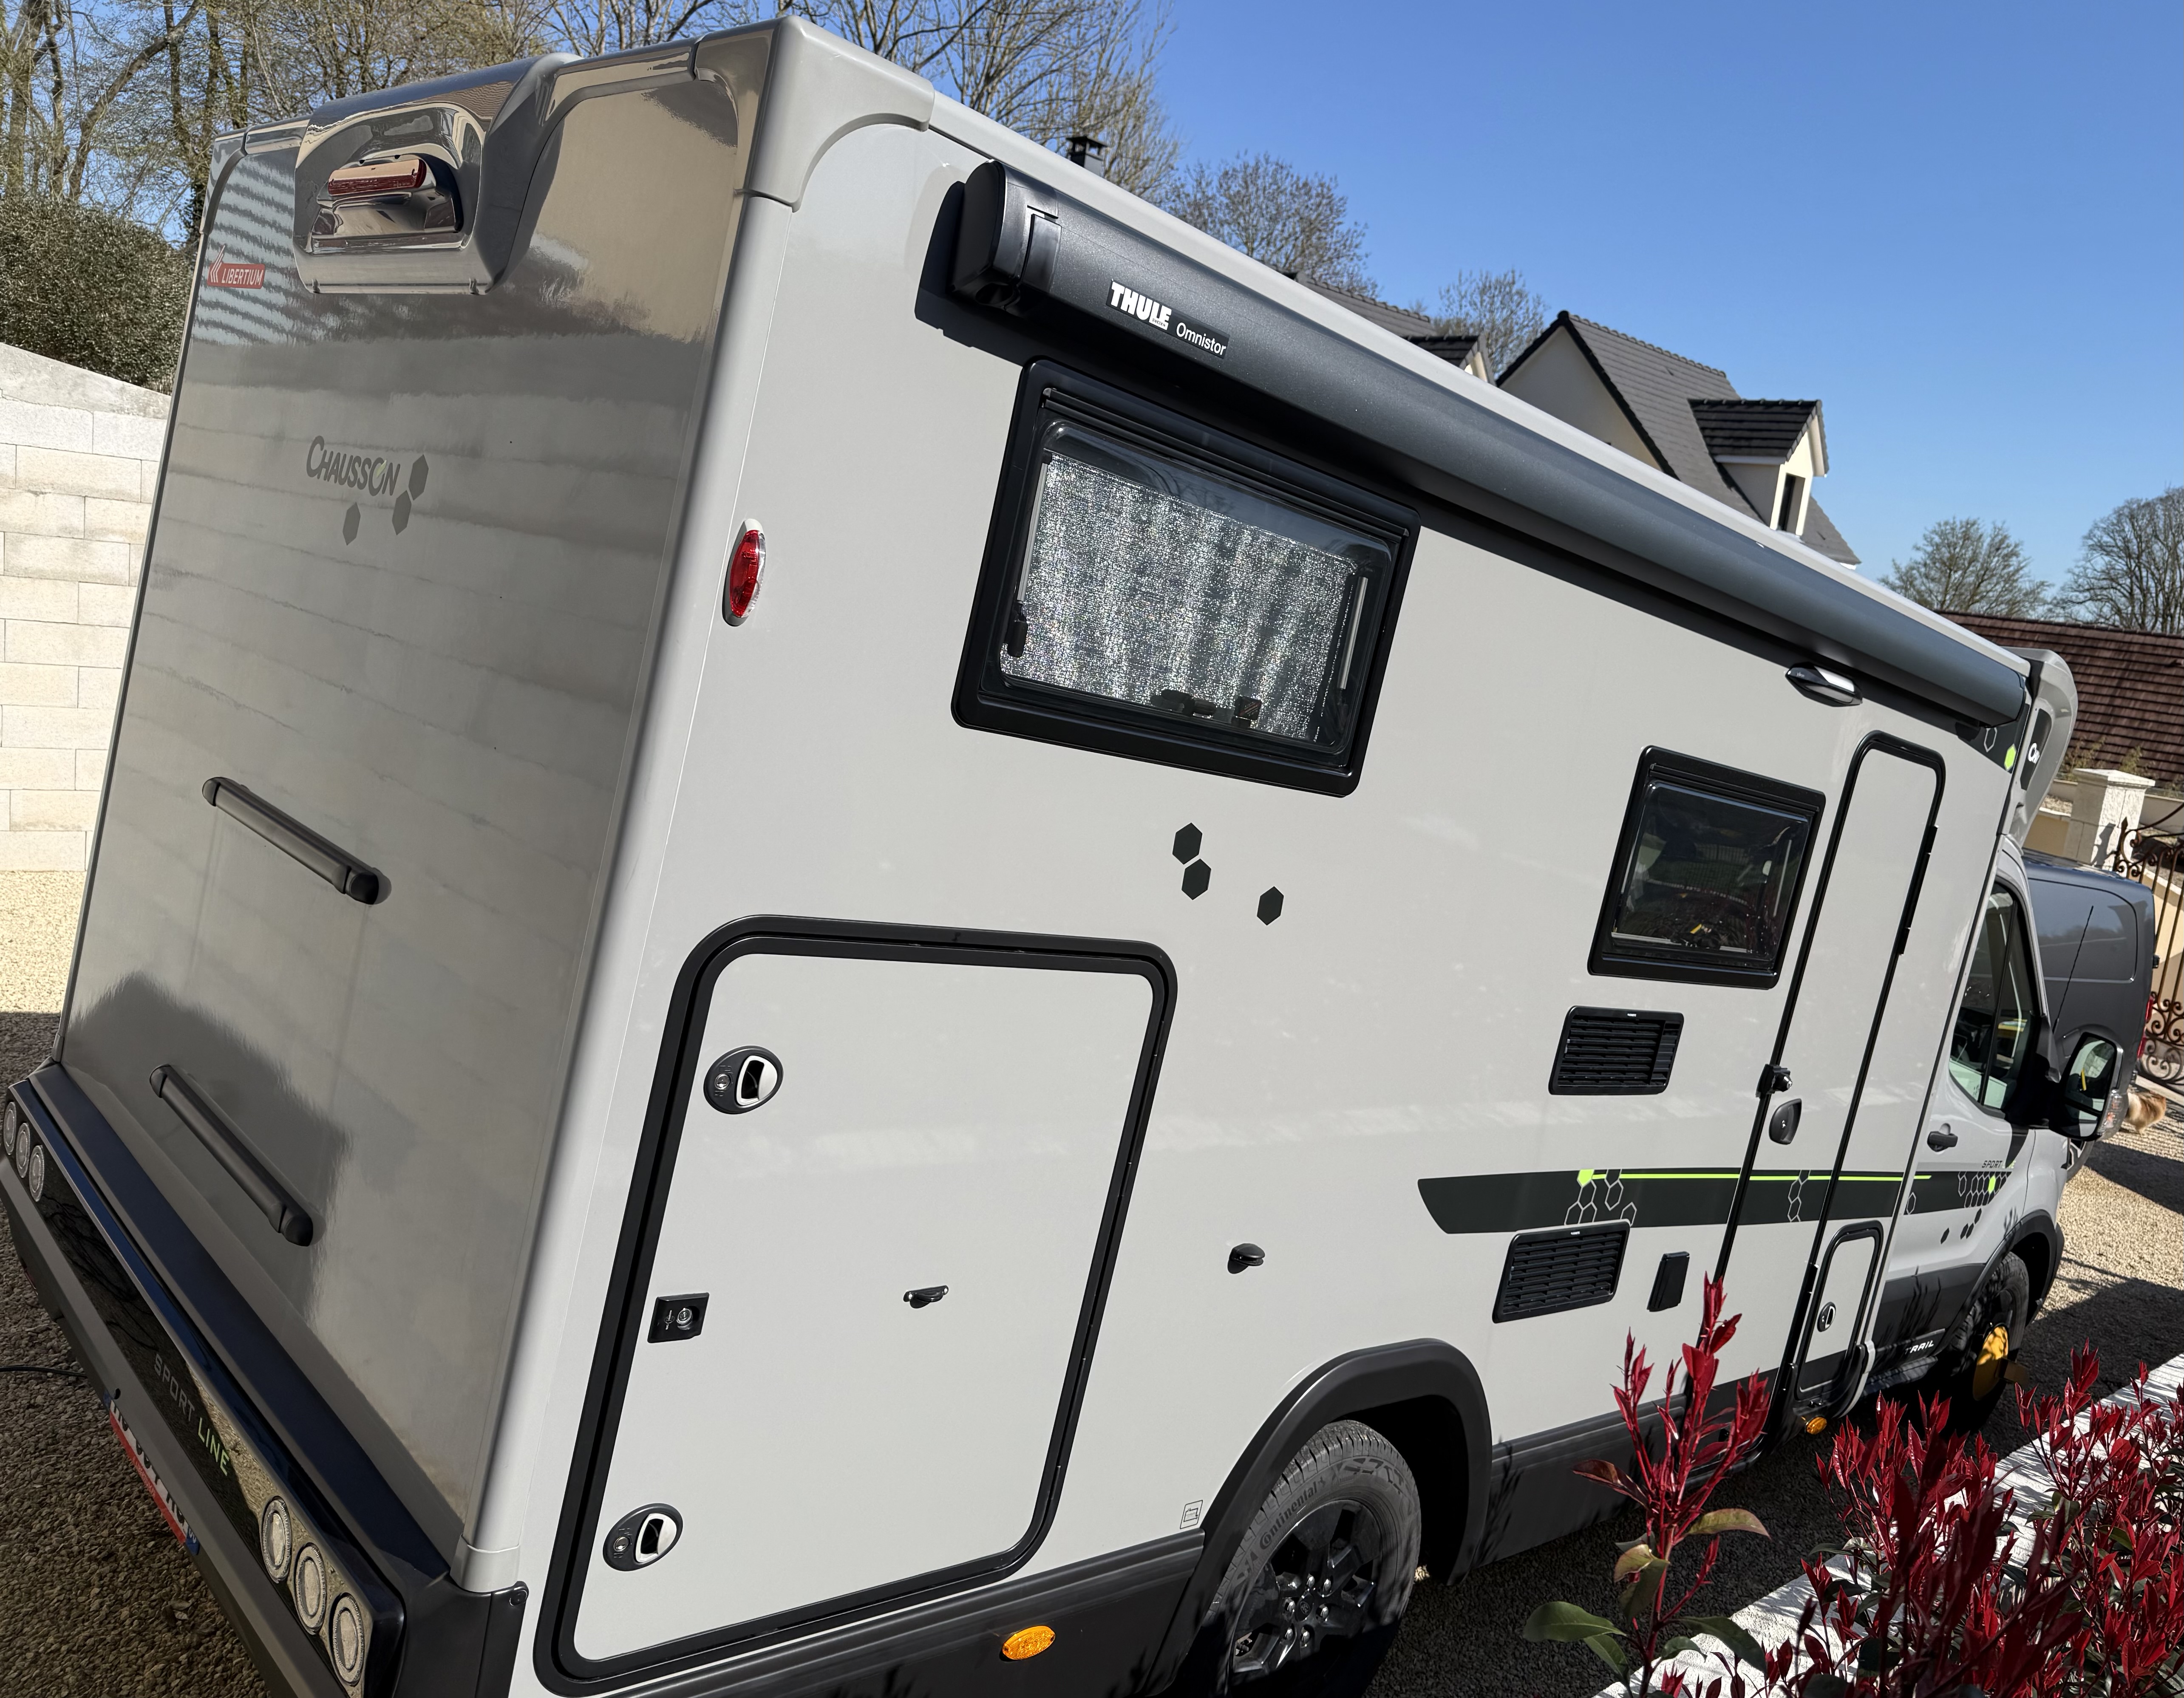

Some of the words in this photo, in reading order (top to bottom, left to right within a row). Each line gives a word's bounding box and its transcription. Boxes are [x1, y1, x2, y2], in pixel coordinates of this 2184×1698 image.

[221, 268, 263, 285] LIBERTIUM
[1111, 281, 1172, 330] THULE
[1176, 322, 1226, 355] Omnistor
[1982, 1160, 2003, 1169] SPORT
[1905, 1340, 1934, 1355] TRAIL
[154, 1353, 195, 1421] SPORT
[198, 1417, 229, 1476] LINE
[1260, 1481, 1317, 1550] Continental
